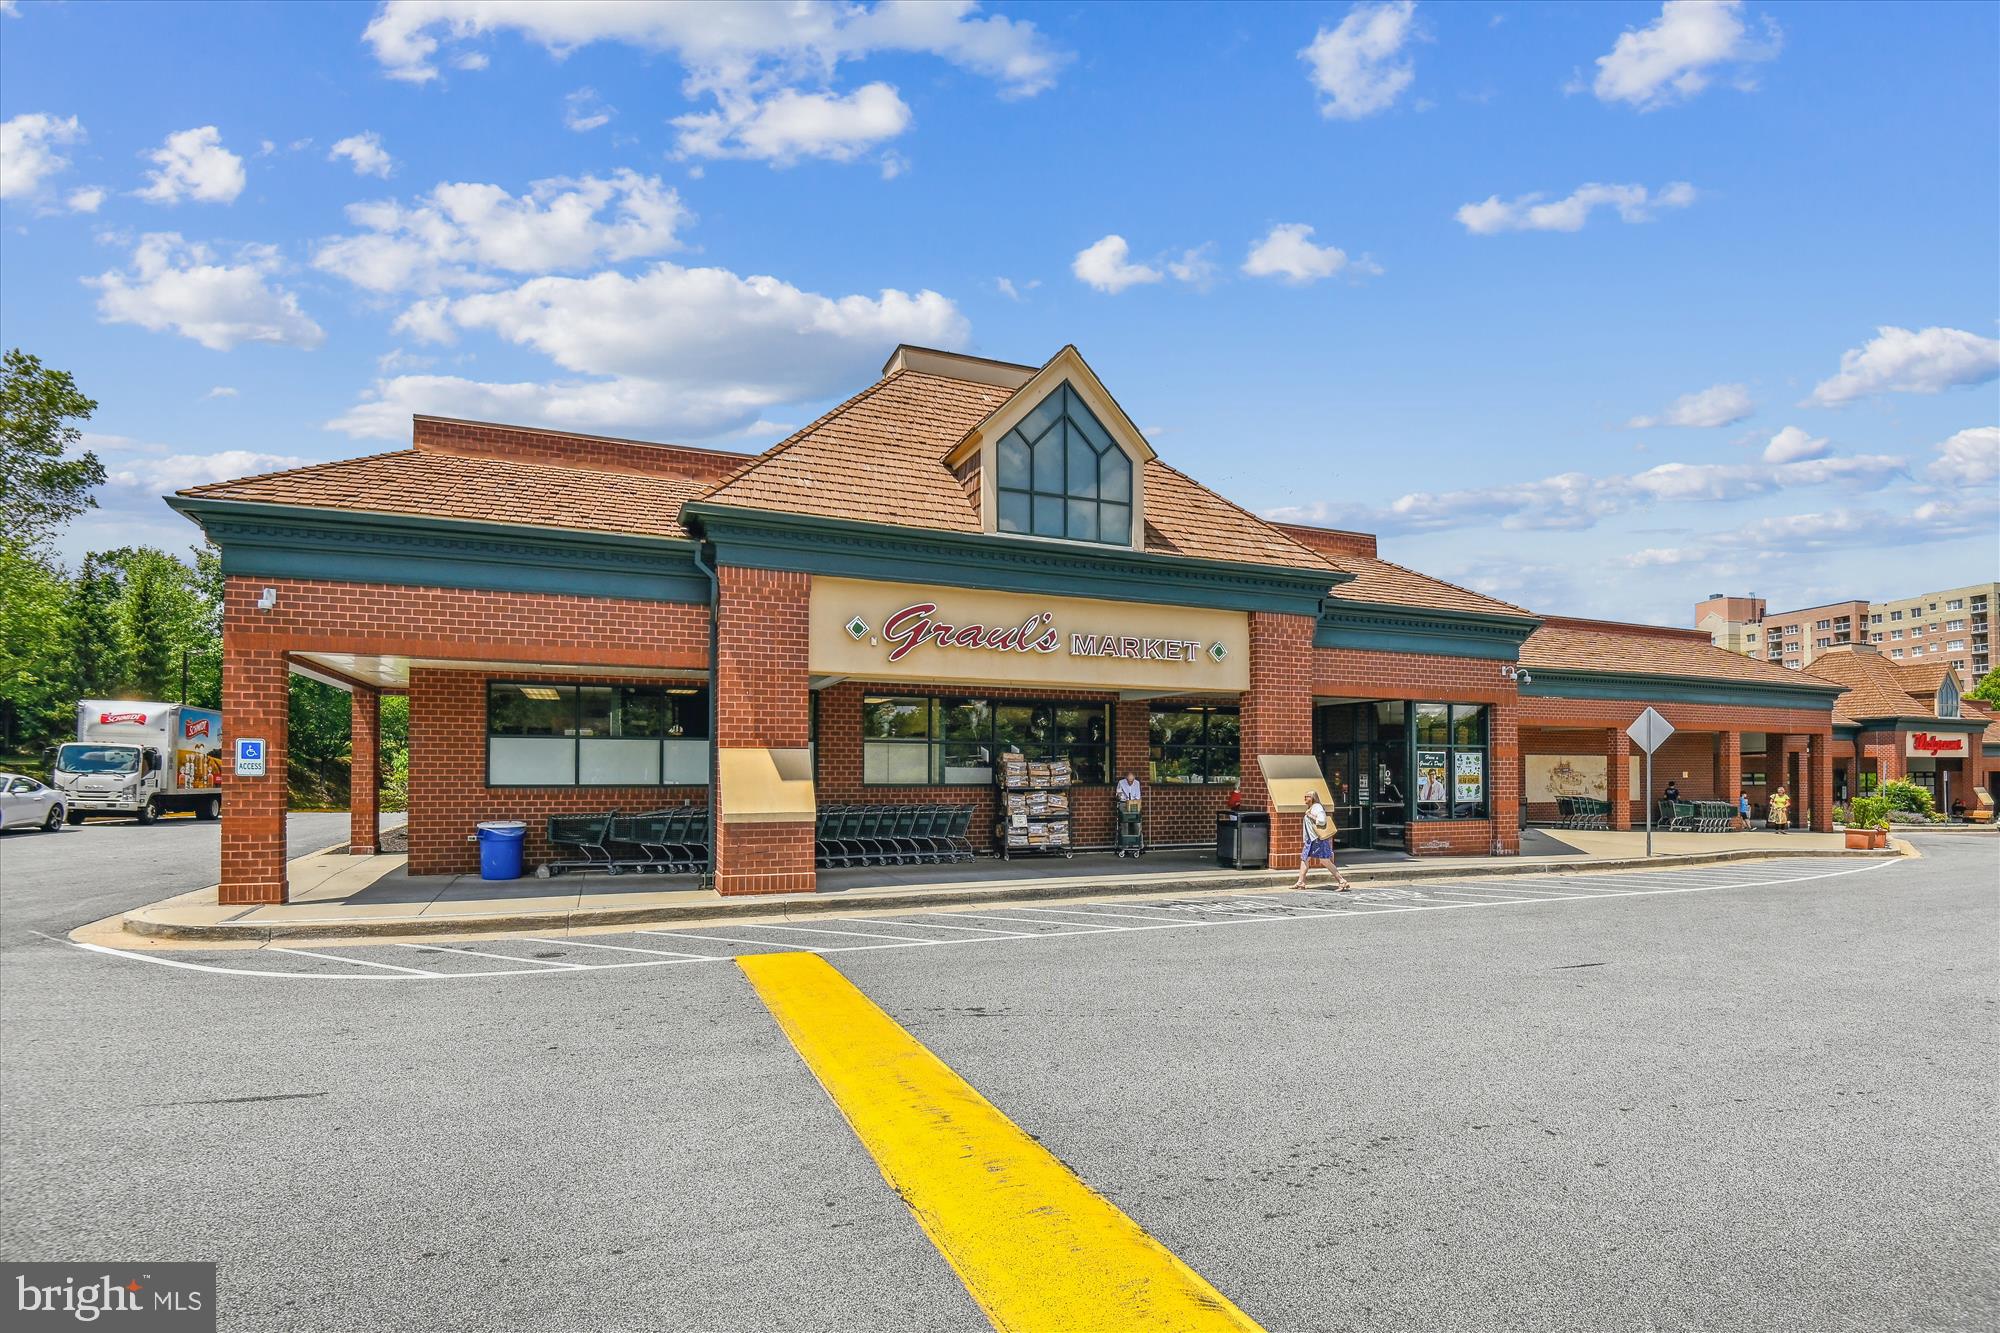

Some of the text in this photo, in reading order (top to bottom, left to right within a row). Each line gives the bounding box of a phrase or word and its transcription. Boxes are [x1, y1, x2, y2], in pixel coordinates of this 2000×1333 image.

[883, 602, 1202, 662] Graul's MARKET
[239, 762, 262, 770] ACCESS
